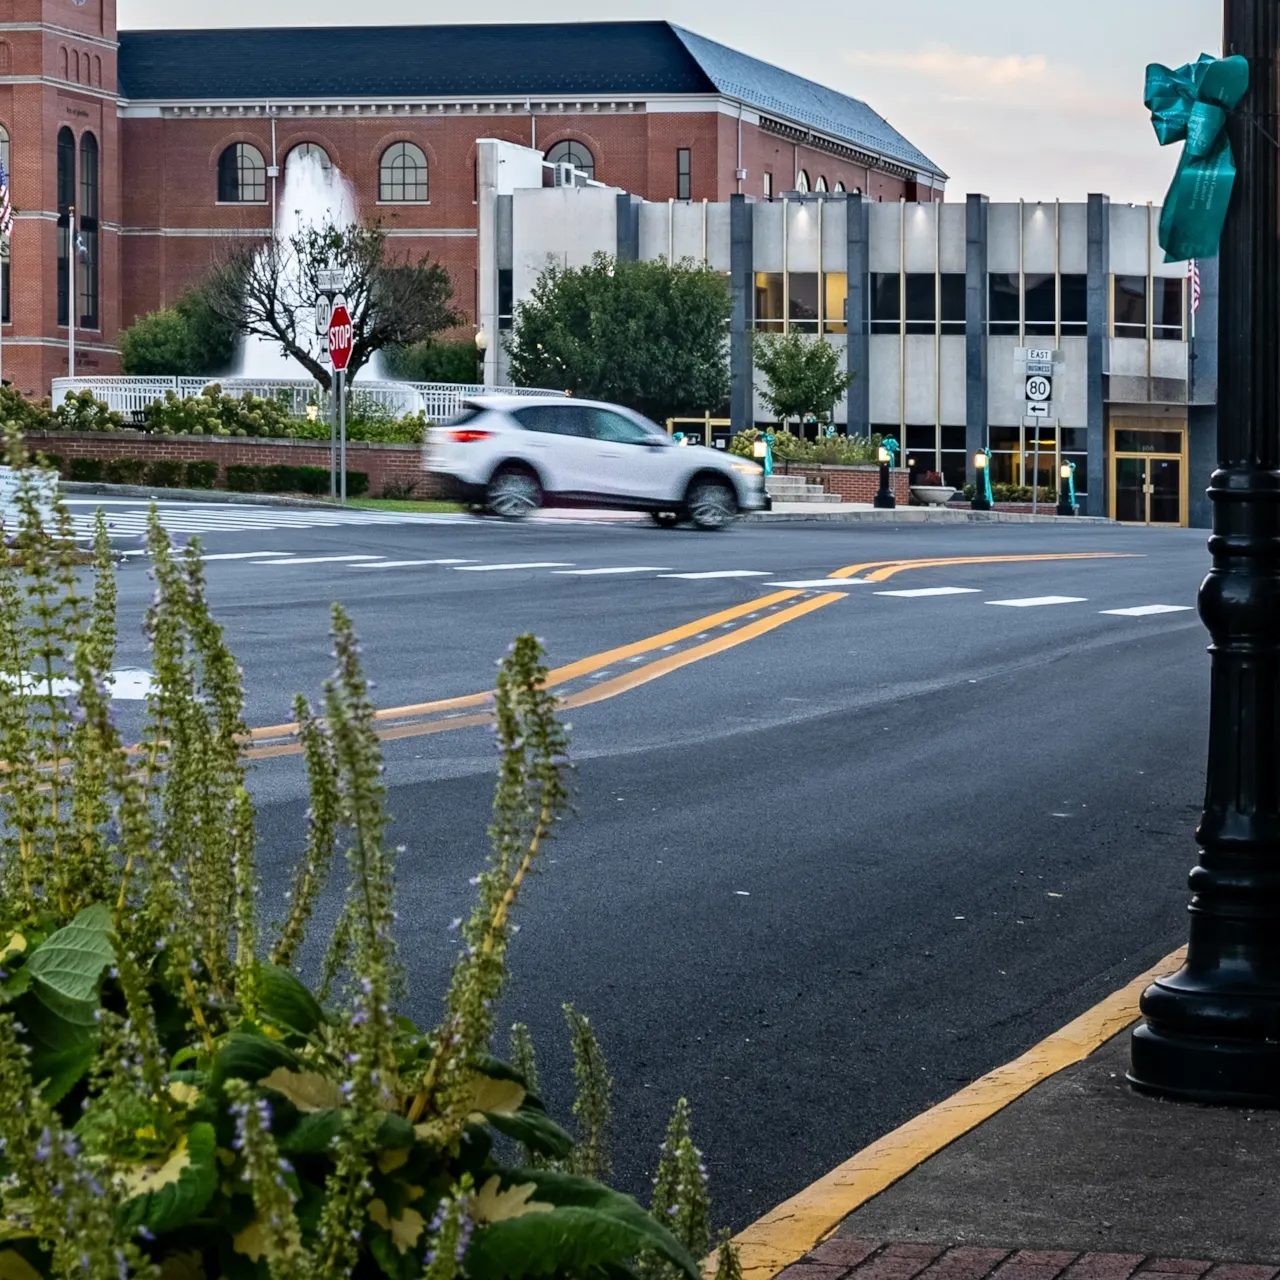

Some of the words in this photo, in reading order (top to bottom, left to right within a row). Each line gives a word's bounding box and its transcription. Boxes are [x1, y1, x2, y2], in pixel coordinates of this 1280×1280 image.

[330, 325, 350, 351] STOP
[1030, 350, 1049, 360] EAST
[1028, 365, 1050, 373] BUSINESS
[1030, 381, 1046, 395] 80
